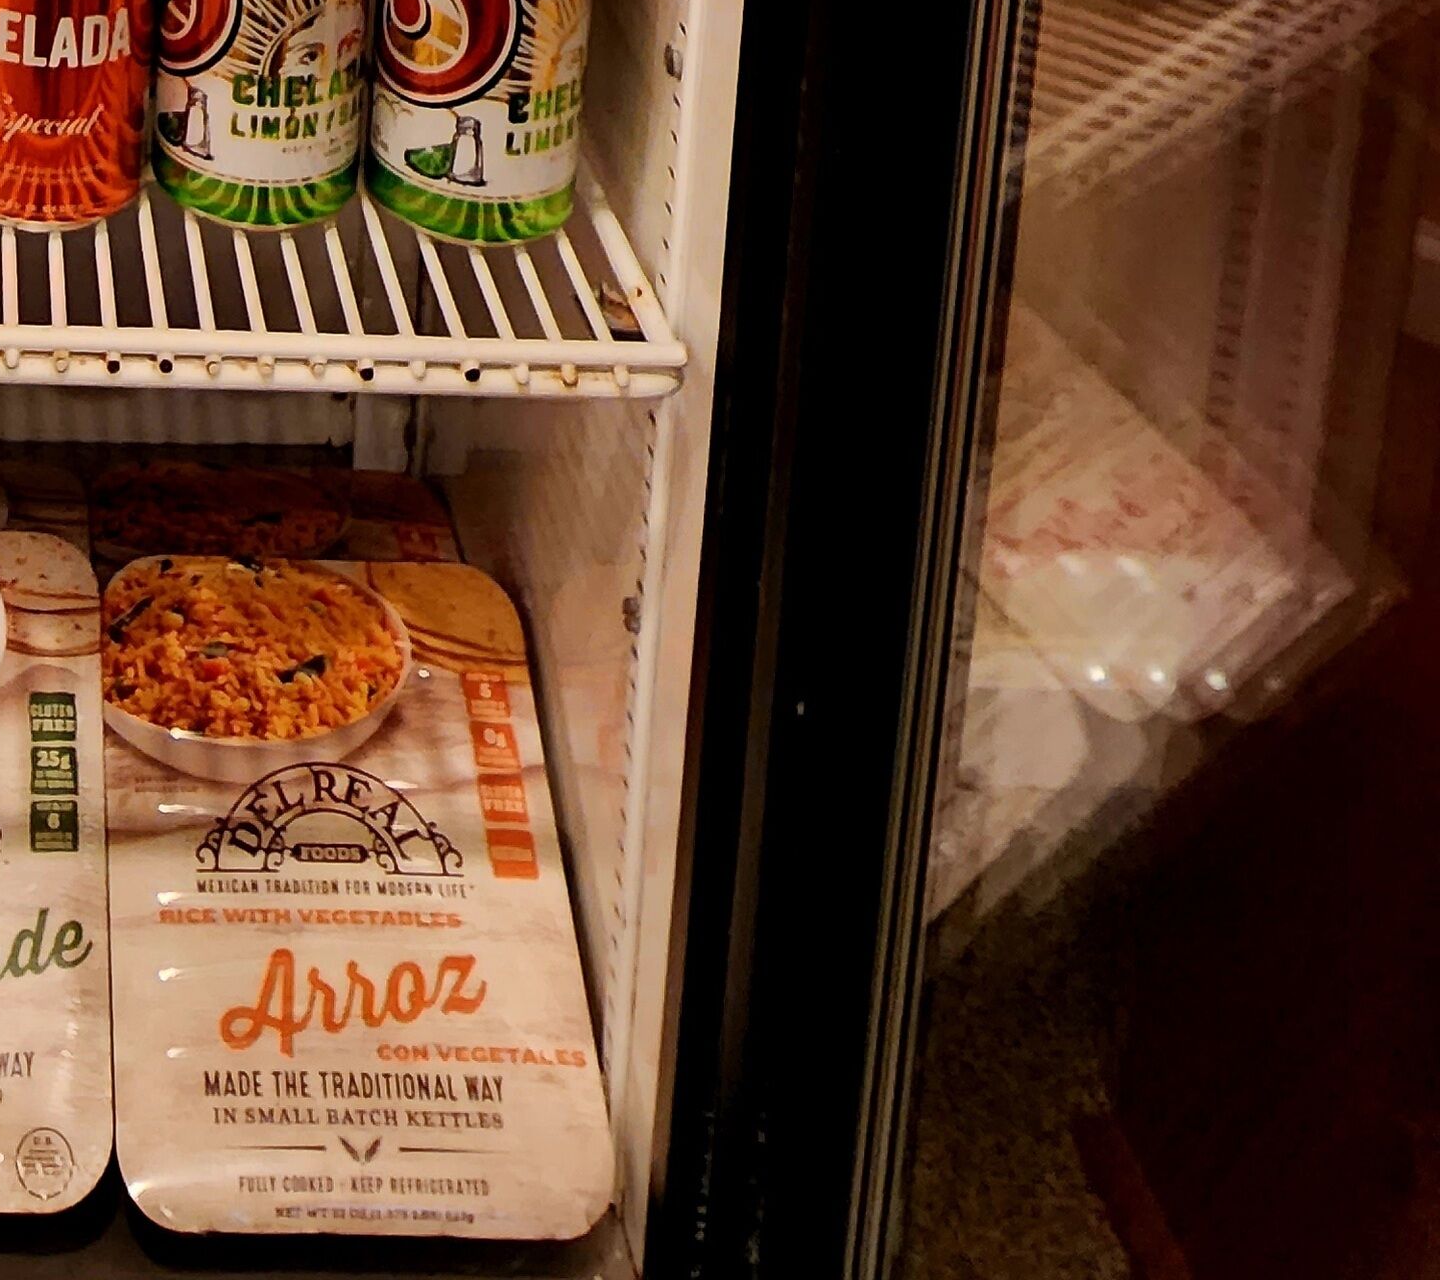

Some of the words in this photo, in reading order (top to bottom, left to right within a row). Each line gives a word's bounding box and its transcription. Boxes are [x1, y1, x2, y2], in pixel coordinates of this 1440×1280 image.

[228, 778, 305, 858] DEL
[312, 766, 430, 862] REAL
[298, 846, 363, 862] FOODS
[196, 878, 259, 894] MEXICAN
[265, 878, 339, 895] TRADITION
[345, 880, 371, 896] FOR
[376, 881, 434, 898] MODERN
[158, 907, 219, 925] RICE
[221, 908, 292, 926] WITH
[300, 908, 464, 930] VEGETABLES
[218, 946, 488, 1059] Arroz
[375, 1043, 431, 1063] CON
[435, 1043, 588, 1069] VEGETALES
[203, 1069, 265, 1098] MADE
[271, 1070, 310, 1099] THE
[317, 1071, 455, 1103] TRADITIONAL
[463, 1074, 505, 1103] WAY
[212, 1106, 237, 1125] IN
[244, 1107, 320, 1126] SMALL
[327, 1108, 399, 1128] BATCH
[405, 1110, 506, 1131] KETTLES
[237, 1174, 277, 1195] FULLY
[350, 1176, 385, 1196] KEEP
[389, 1177, 491, 1197] REFRIGERATED
